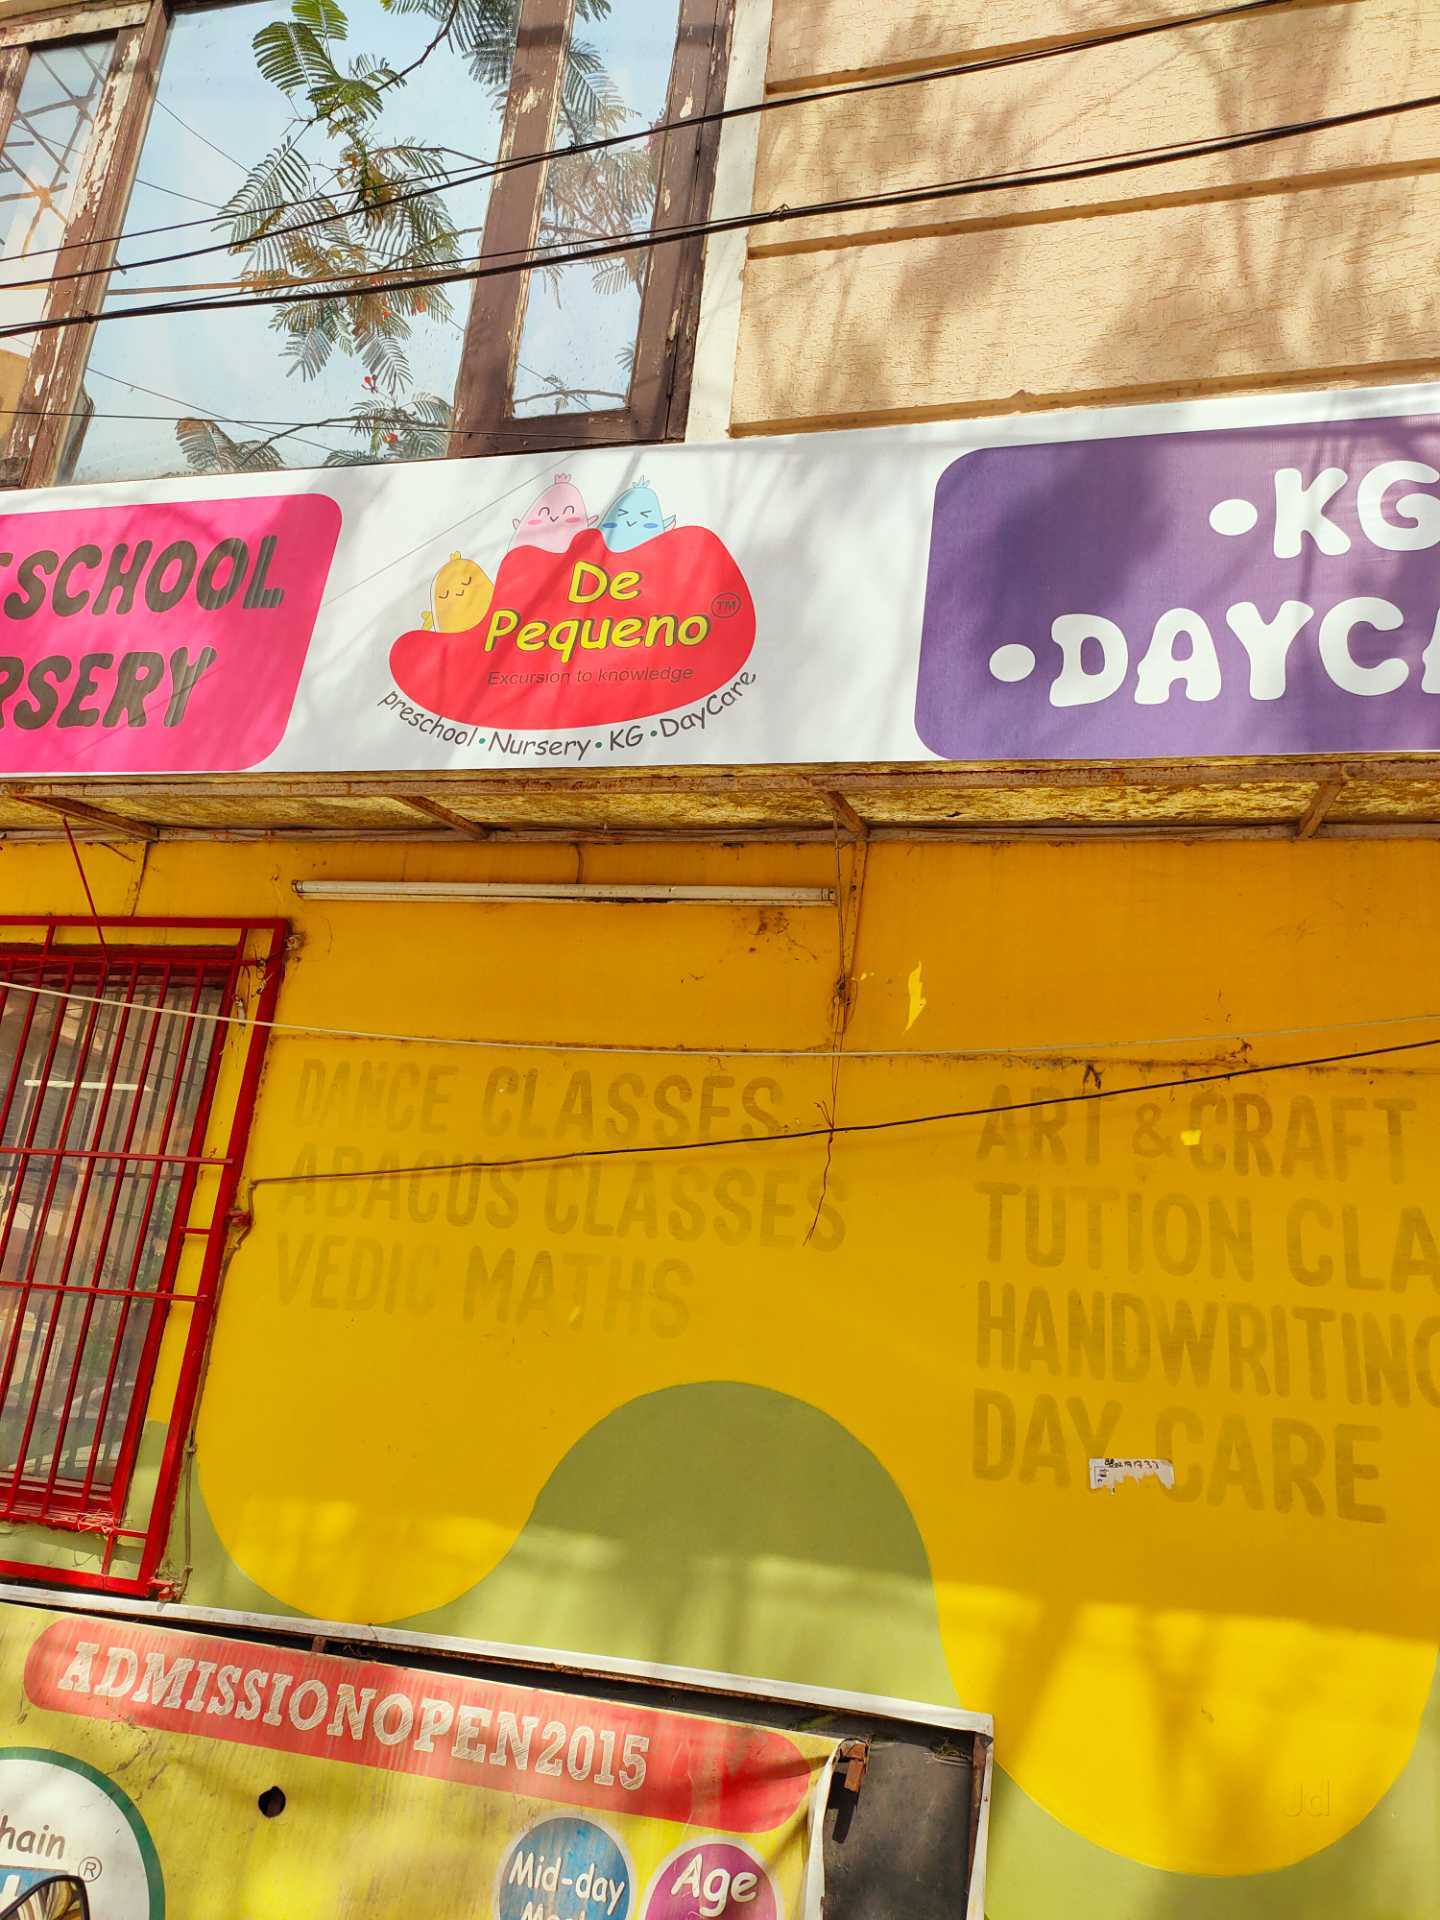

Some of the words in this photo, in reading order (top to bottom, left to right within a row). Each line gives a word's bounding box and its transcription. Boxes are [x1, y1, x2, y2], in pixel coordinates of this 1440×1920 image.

[1273, 460, 1440, 559] KG
[0, 534, 285, 621] SCHOOL
[568, 559, 642, 604] De
[483, 608, 711, 664] Pequeno
[487, 671, 571, 686] Excursion
[577, 669, 593, 684] to
[598, 666, 695, 684] knowledge
[1049, 597, 1440, 708] DAYC
[377, 689, 478, 747] preschool
[488, 730, 591, 761] Nursery
[609, 725, 645, 752] KG
[659, 671, 757, 737] DayCare
[296, 1058, 459, 1136] DANCE
[976, 1083, 1111, 1167] ART
[1187, 1088, 1417, 1184] CRAFT
[275, 1142, 523, 1229] ABACUS
[543, 1159, 849, 1254] CLASSES
[973, 1180, 1255, 1283] TUTION
[275, 1231, 441, 1317] VEDIC
[462, 1244, 695, 1341] MATHS
[972, 1386, 1123, 1488] DAY
[1154, 1405, 1388, 1525] CARE
[508, 1851, 625, 1916] Mid-day
[670, 1853, 758, 1918] Age
